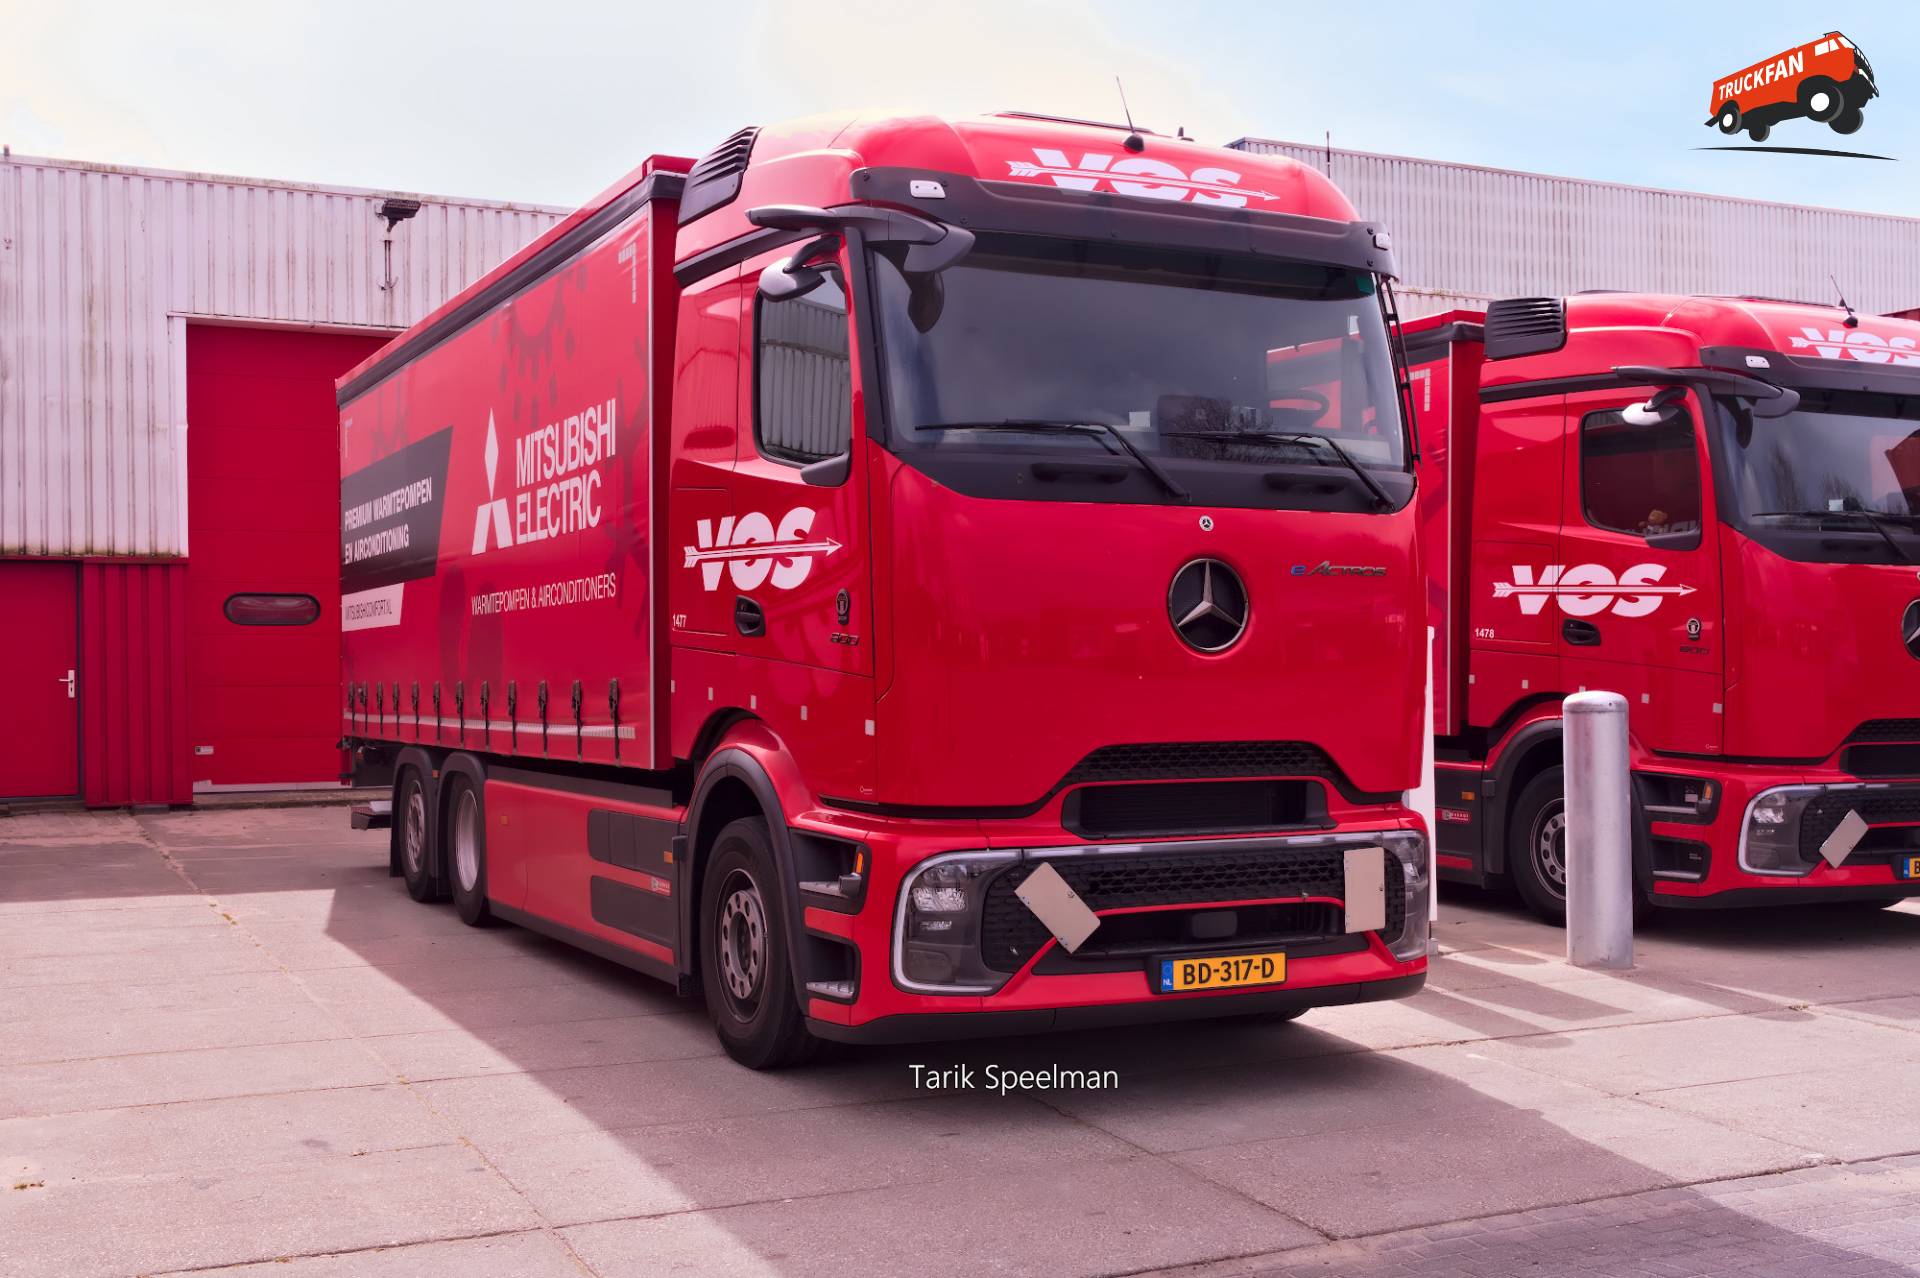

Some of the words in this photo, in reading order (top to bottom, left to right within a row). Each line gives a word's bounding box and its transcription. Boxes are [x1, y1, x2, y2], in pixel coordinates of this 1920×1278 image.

[1032, 148, 1248, 208] VOS
[516, 398, 616, 488] MITSUBISHI
[345, 501, 372, 531] PREMIUM
[373, 477, 432, 521] WARMTEPOMPEN
[516, 469, 602, 545] ELECTRIC
[345, 541, 354, 565] EN
[354, 523, 410, 563] AIRCONDITIONING
[697, 506, 816, 591] VOS
[471, 587, 530, 615] WARMTEPOMPEN
[538, 572, 616, 607] AIRCONDITIONERS
[1512, 563, 1668, 617] VOS
[672, 613, 687, 628] 1477
[1475, 627, 1495, 639] 1478
[1183, 957, 1275, 985] BD-317-D
